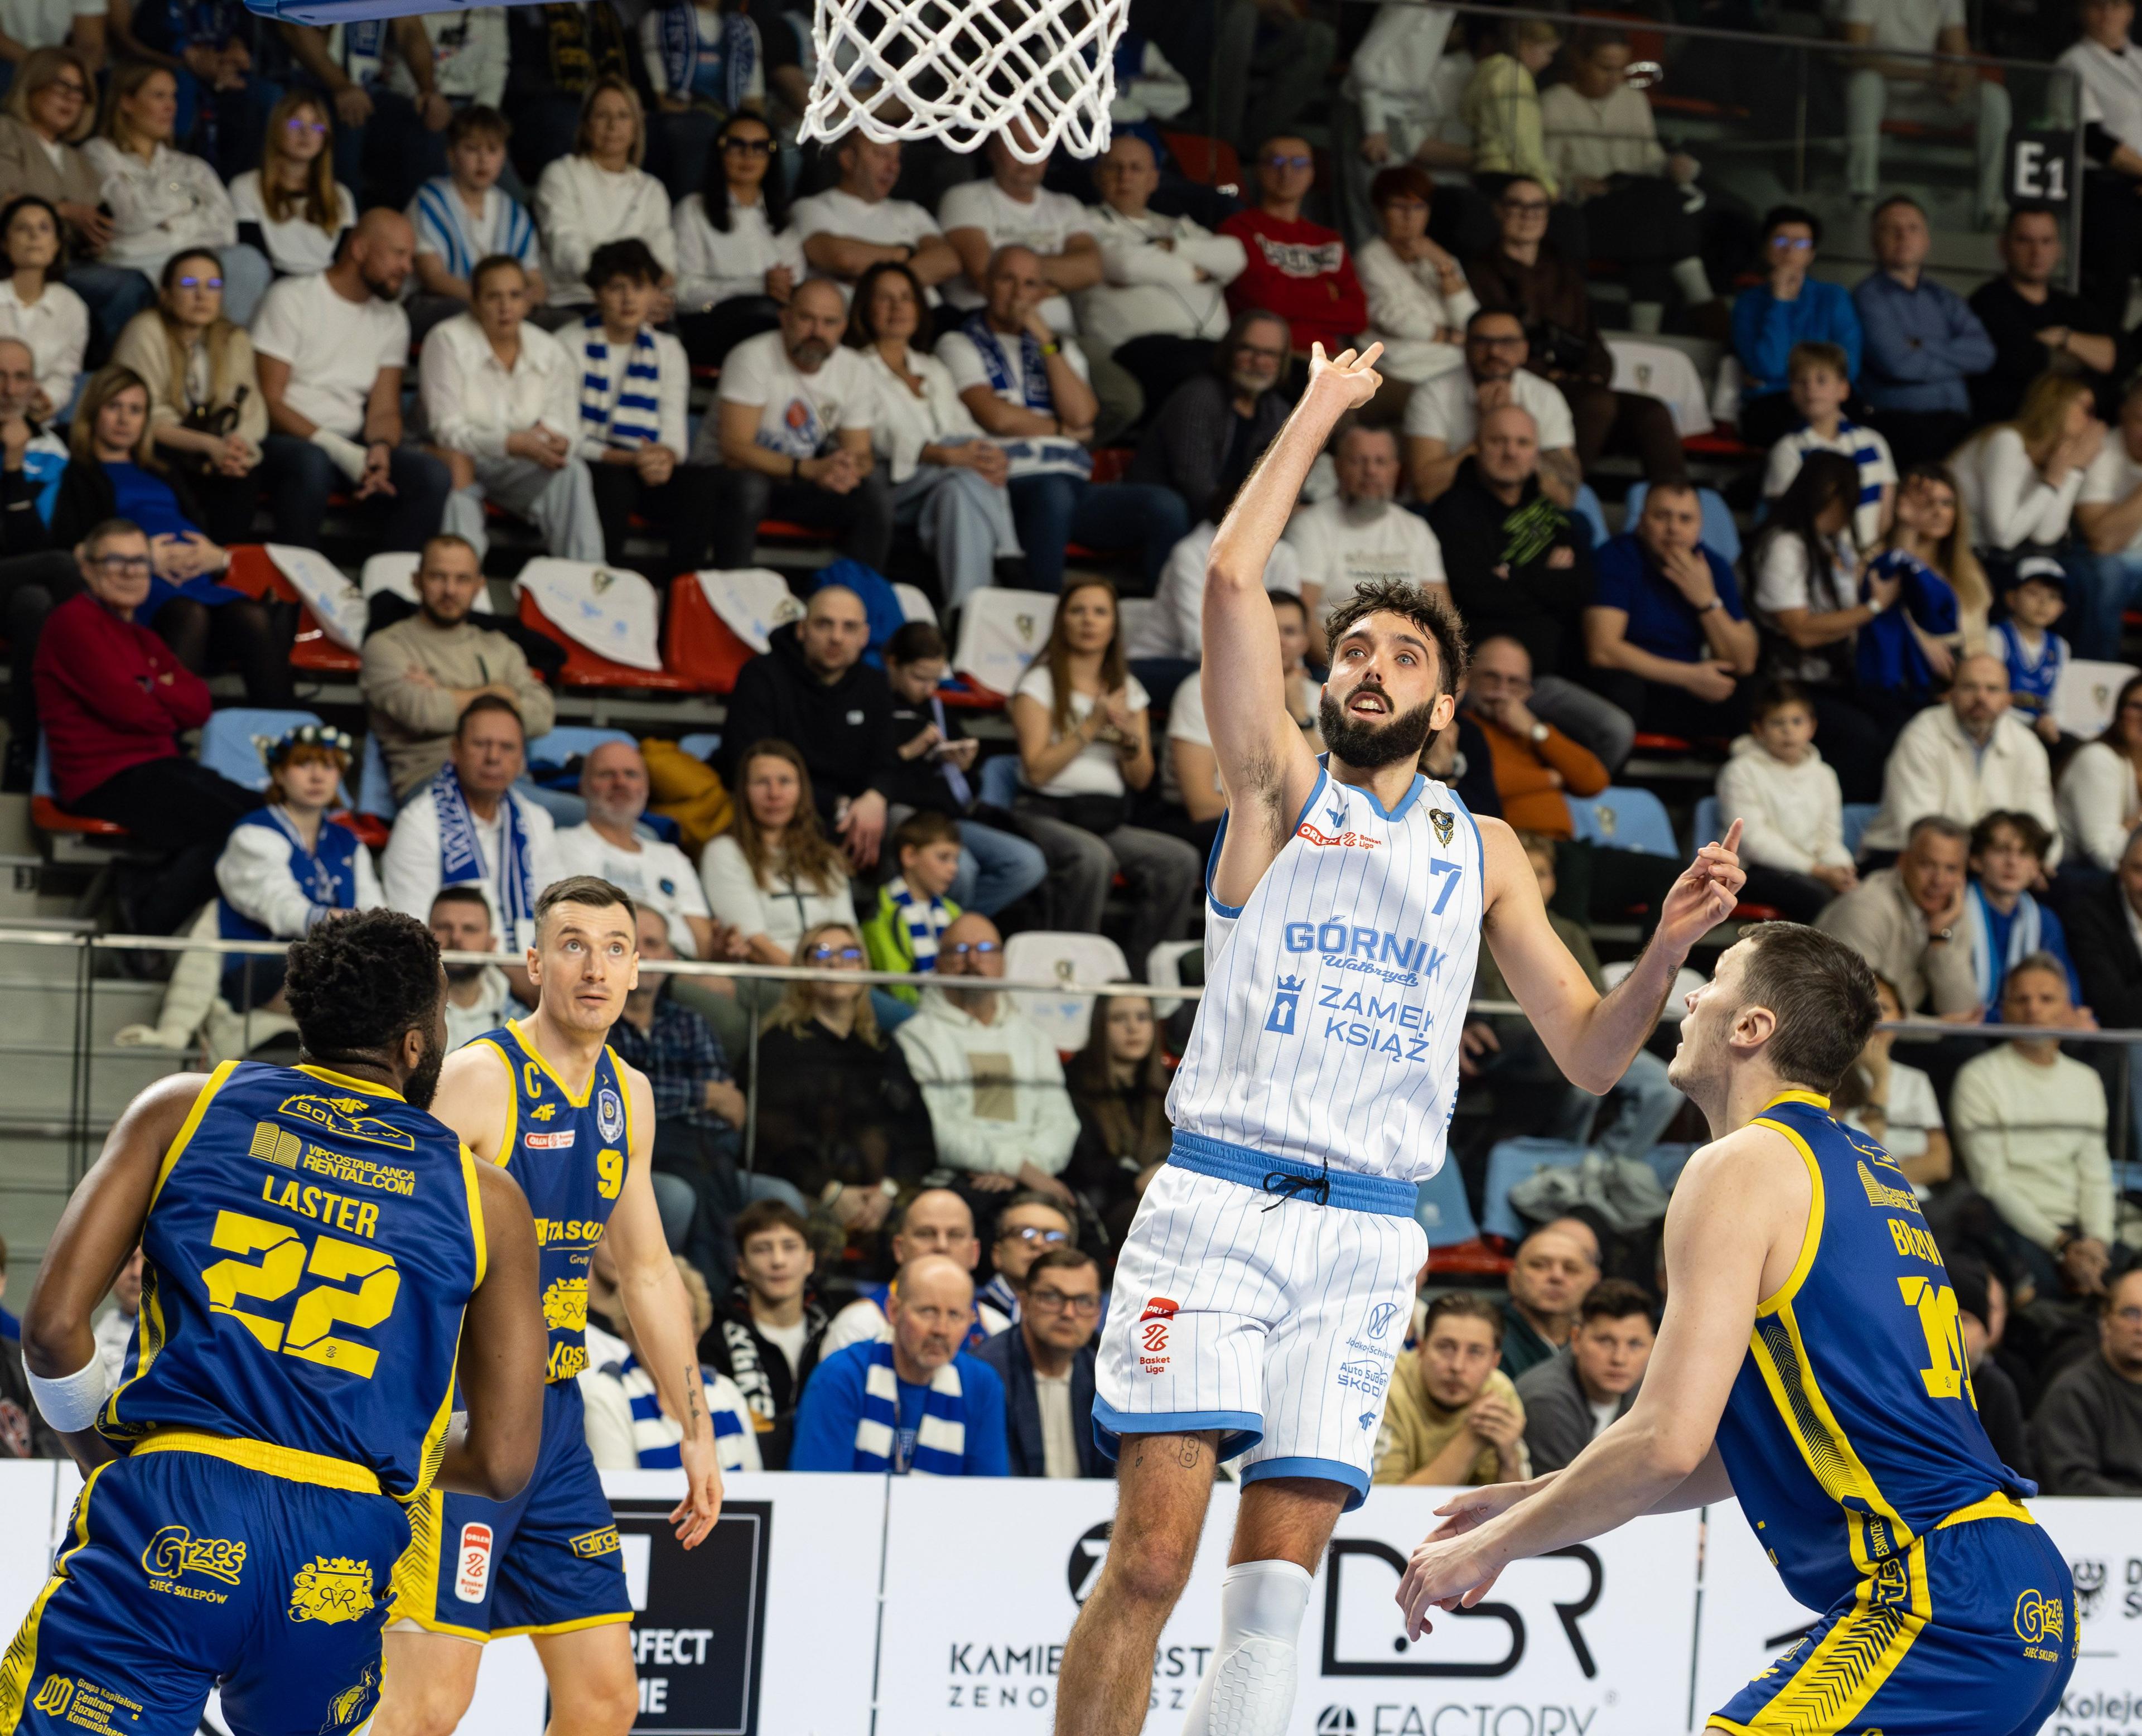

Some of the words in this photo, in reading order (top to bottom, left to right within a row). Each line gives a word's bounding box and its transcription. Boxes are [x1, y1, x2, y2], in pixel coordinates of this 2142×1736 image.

[2014, 141, 2068, 200] E1
[1298, 823, 1340, 844] ORLEN
[1360, 835, 1382, 845] Basket
[1430, 857, 1463, 916] 7
[1285, 915, 1449, 984] GÓRNIK
[1325, 1017, 1430, 1063] KSIĄŻ
[523, 1062, 542, 1098] C
[303, 1154, 415, 1196] RENTAL.COM
[308, 1144, 416, 1182] VIPCOSTABLANCA
[596, 1149, 624, 1200] 9
[262, 1175, 379, 1238] LASTER
[201, 1209, 401, 1379] 22
[1140, 1356, 1171, 1364] Basket
[1145, 1366, 1164, 1375] Liga
[1340, 1362, 1363, 1377] Auto
[1366, 1370, 1388, 1387] Sudet
[142, 1525, 247, 1585] Grześ
[149, 1579, 173, 1594] SIEĆ
[175, 1585, 229, 1604] SKLEPÓW
[71, 1700, 110, 1724] Rozwoju
[76, 1690, 115, 1714] Centrum
[77, 1678, 99, 1694] Grupa
[100, 1687, 143, 1713] Kapitałowa
[1374, 1705, 1598, 1736] FACTORY
